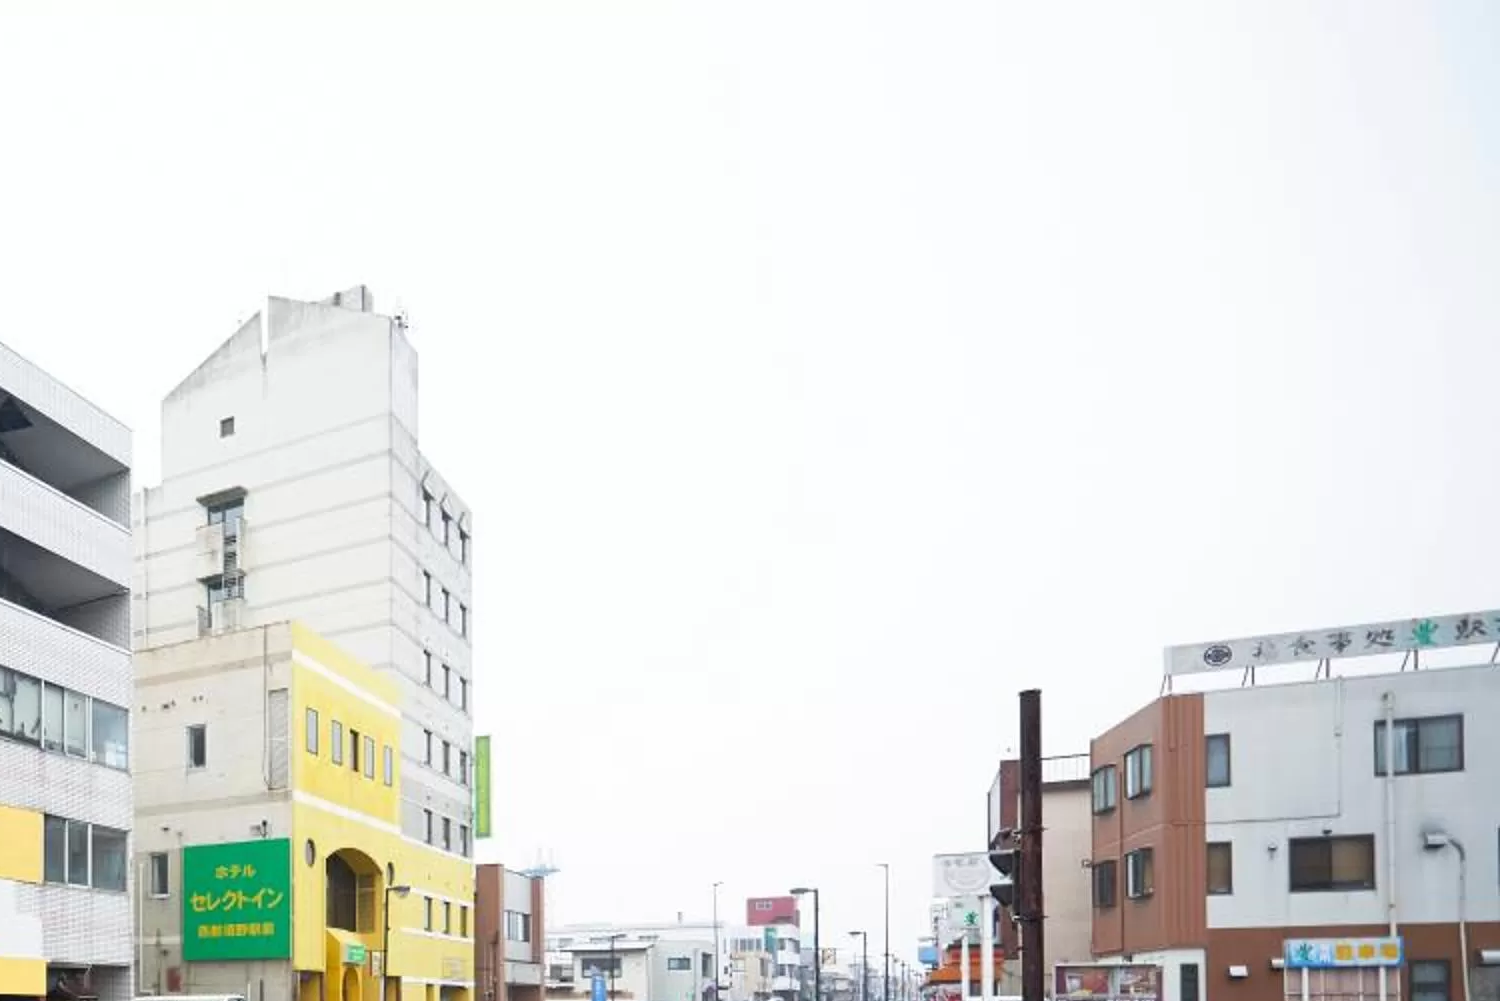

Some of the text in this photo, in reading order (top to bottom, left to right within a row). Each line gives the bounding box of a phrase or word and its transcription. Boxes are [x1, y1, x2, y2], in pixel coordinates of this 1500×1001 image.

[214, 864, 256, 879] ホテル
[189, 887, 283, 912] セレクトイン
